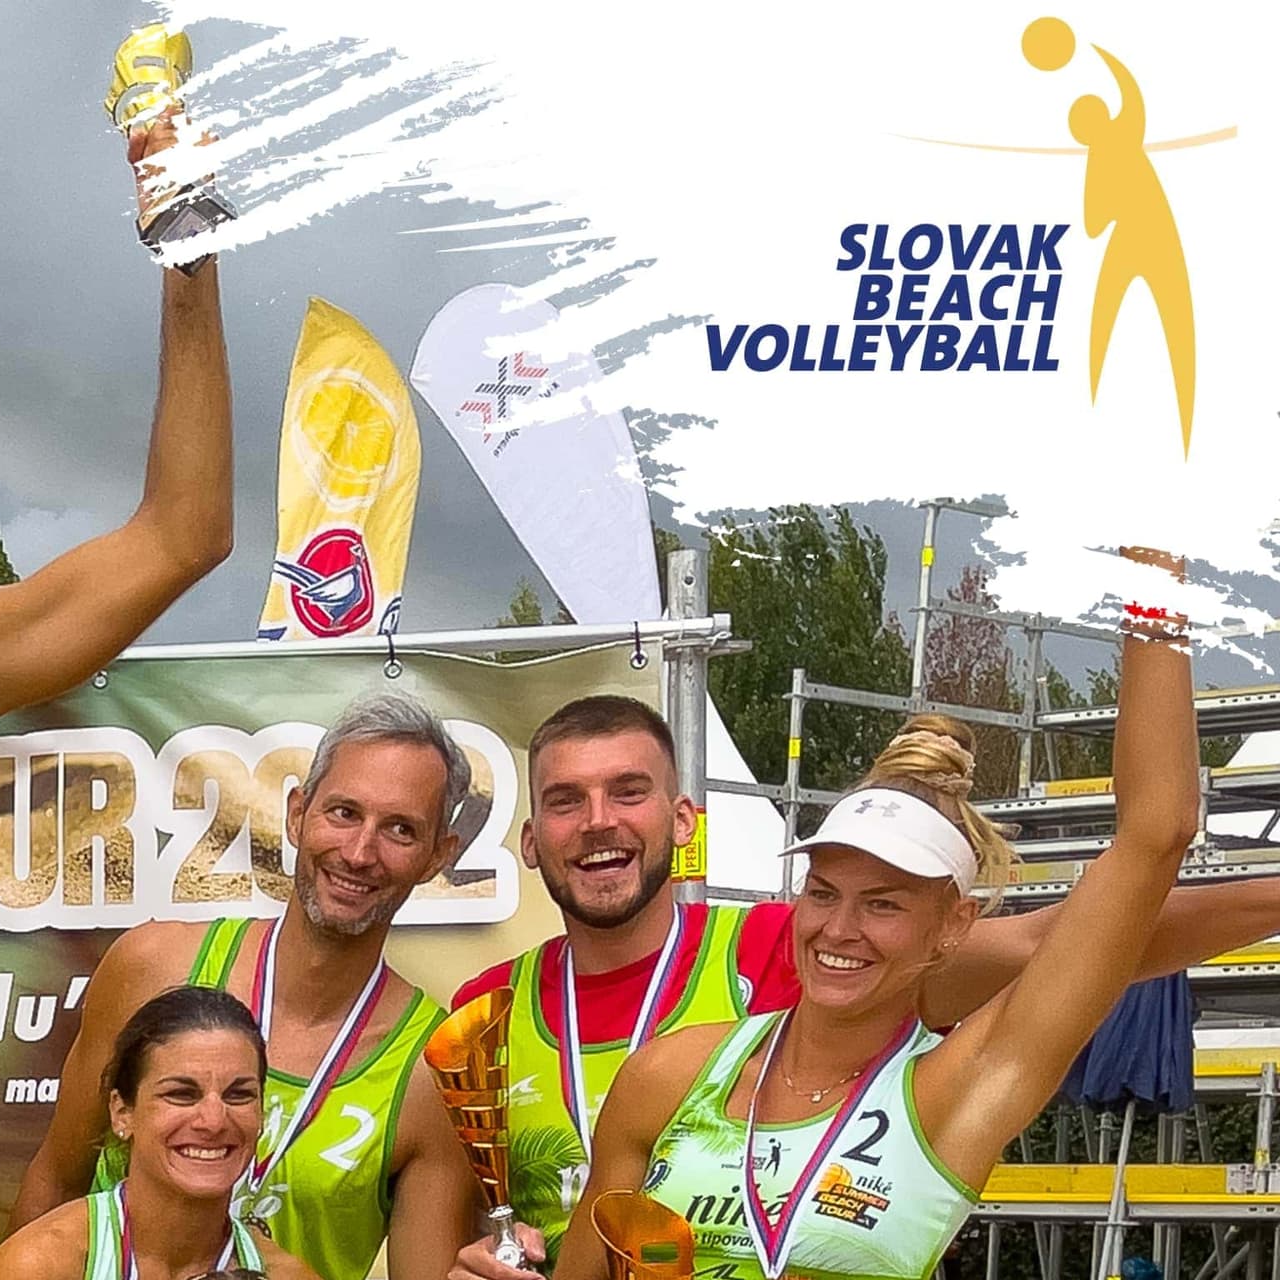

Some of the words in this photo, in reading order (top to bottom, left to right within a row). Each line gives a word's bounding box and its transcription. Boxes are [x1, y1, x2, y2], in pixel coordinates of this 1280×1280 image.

[320, 1104, 378, 1171] 2
[841, 1109, 891, 1166] 2
[856, 1173, 893, 1197] niké
